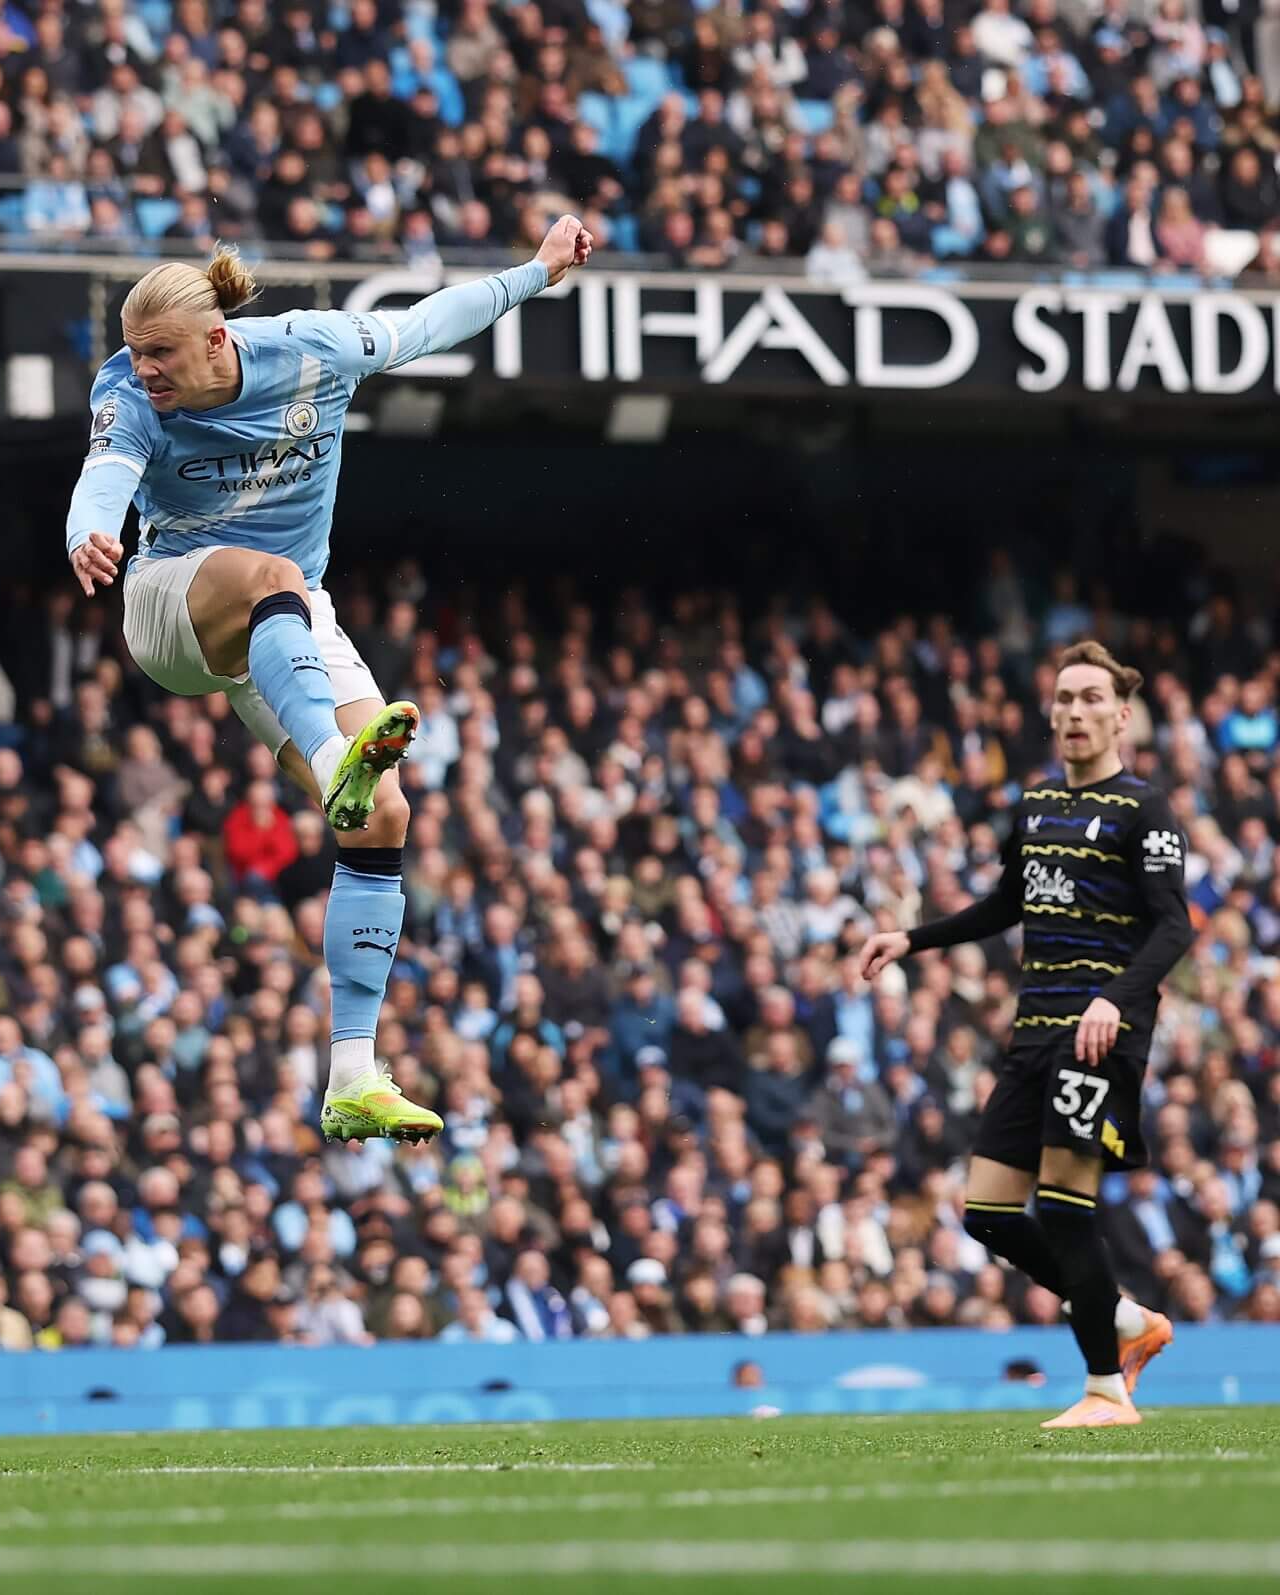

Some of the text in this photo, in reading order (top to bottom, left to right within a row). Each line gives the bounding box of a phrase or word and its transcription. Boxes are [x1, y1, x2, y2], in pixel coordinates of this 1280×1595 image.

[177, 433, 336, 481] ETIHAD
[217, 468, 311, 493] AIRWAYS
[1052, 1068, 1110, 1120] 37
